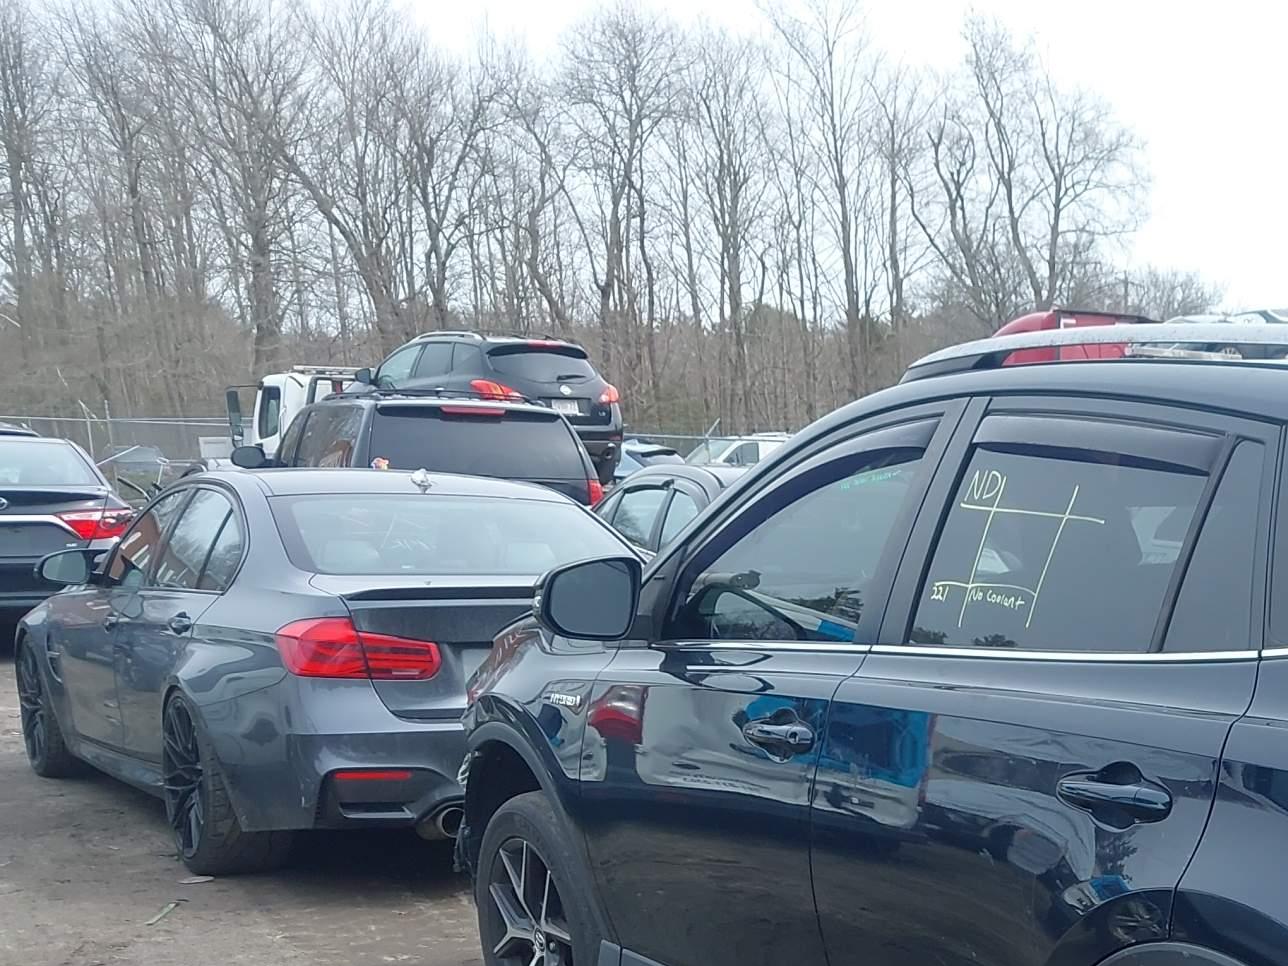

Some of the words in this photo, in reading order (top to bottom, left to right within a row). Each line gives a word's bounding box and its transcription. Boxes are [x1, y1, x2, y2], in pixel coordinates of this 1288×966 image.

[964, 468, 1002, 502] ND
[968, 588, 983, 602] No
[986, 589, 1026, 610] Coolant
